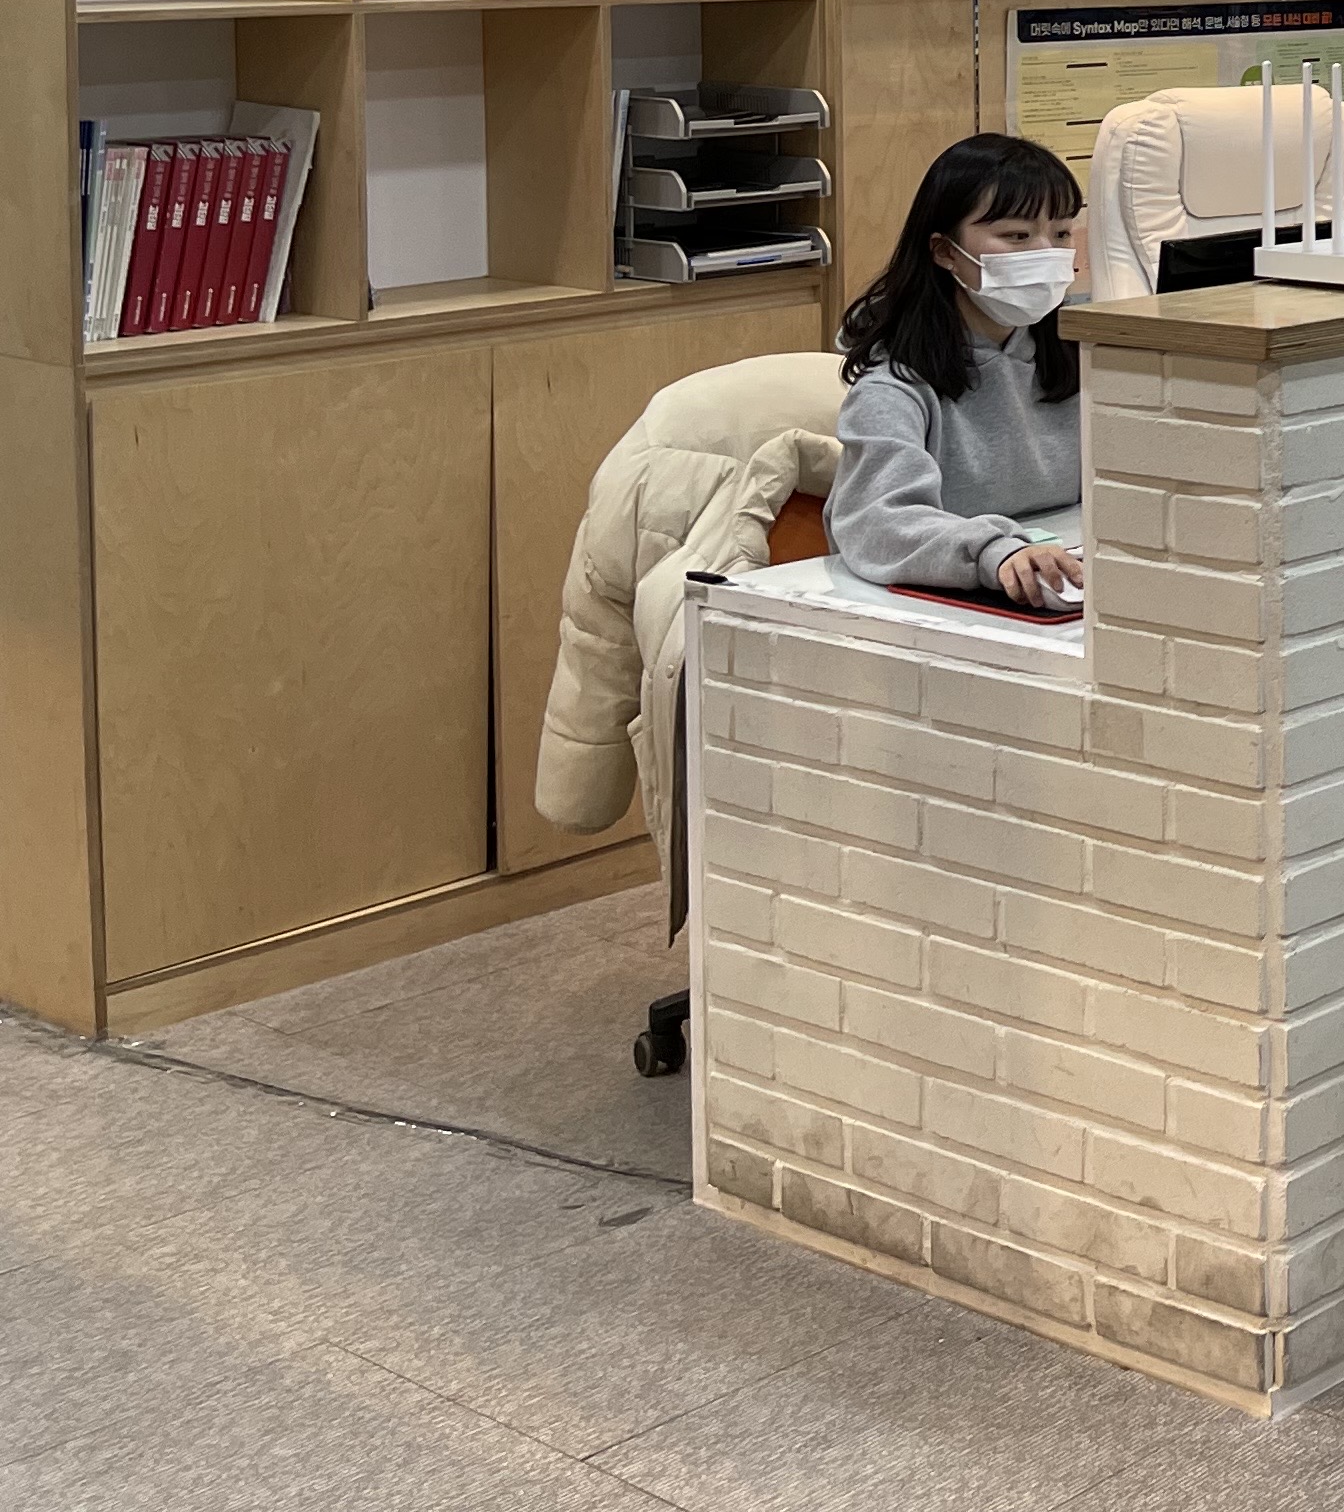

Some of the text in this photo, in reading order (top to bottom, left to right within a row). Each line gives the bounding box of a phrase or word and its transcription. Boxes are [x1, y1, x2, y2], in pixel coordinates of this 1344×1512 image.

[1073, 20, 1112, 38] Syntax
[1113, 18, 1149, 36] Map만
[1151, 17, 1180, 31] 있다면
[1262, 13, 1283, 27] 모든
